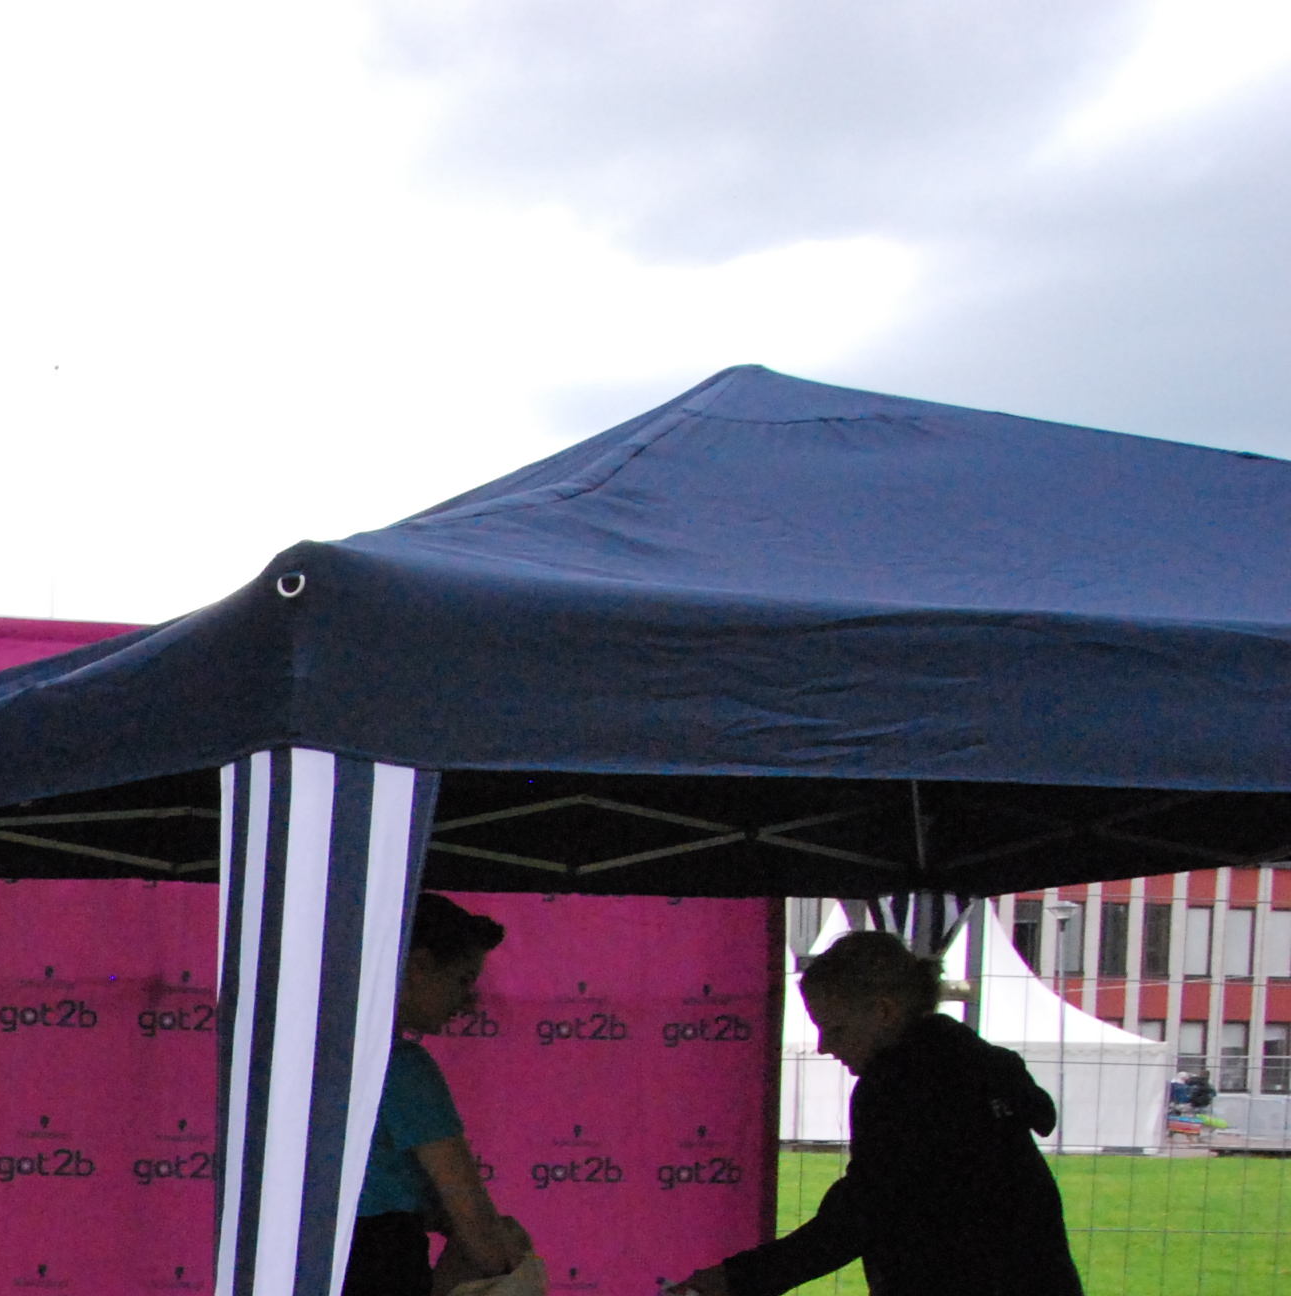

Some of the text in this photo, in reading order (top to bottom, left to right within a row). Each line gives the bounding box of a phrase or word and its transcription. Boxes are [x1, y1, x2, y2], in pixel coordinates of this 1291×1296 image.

[137, 1003, 219, 1038] got2
[536, 1012, 626, 1045] got2b
[662, 1014, 752, 1047] got2b
[531, 1156, 623, 1190] got2b
[658, 1157, 743, 1190] got2b
